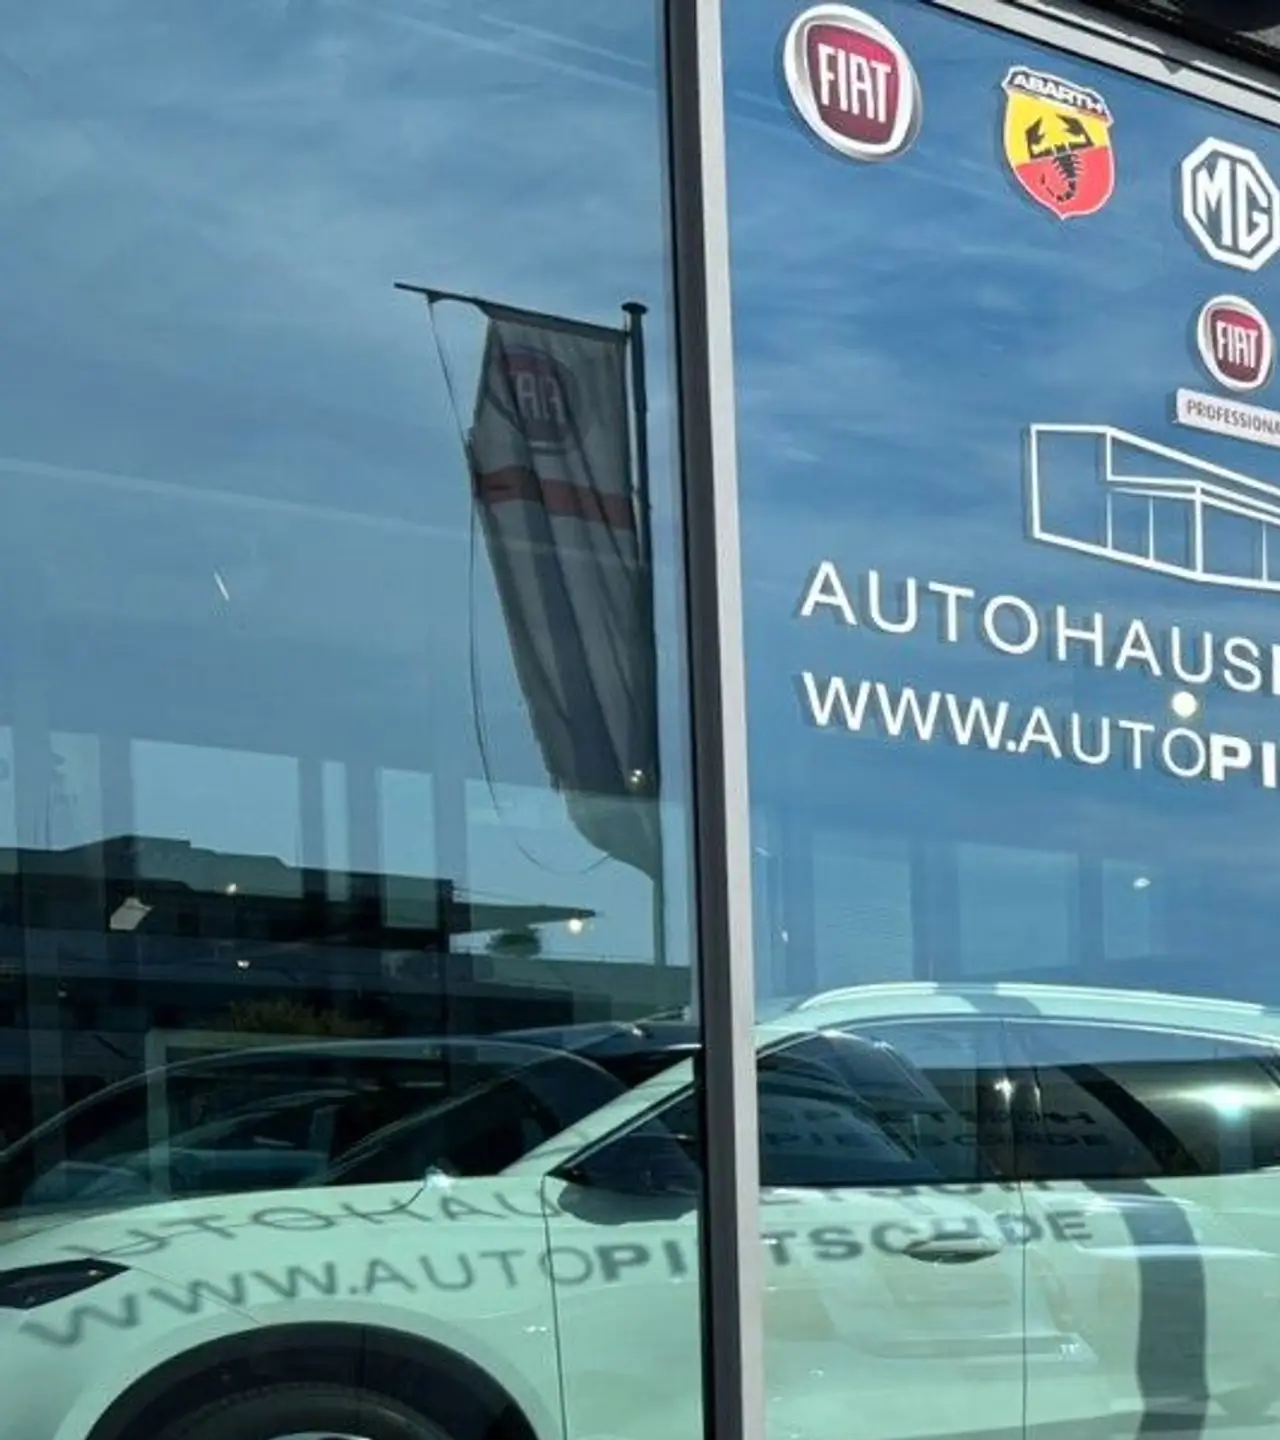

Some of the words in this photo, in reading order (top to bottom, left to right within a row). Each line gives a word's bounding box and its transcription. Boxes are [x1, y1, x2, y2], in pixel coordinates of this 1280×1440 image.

[817, 43, 892, 124] FIAT
[1011, 73, 1108, 117] ABARTH
[1195, 156, 1271, 254] MG
[1216, 318, 1259, 369] FIAT
